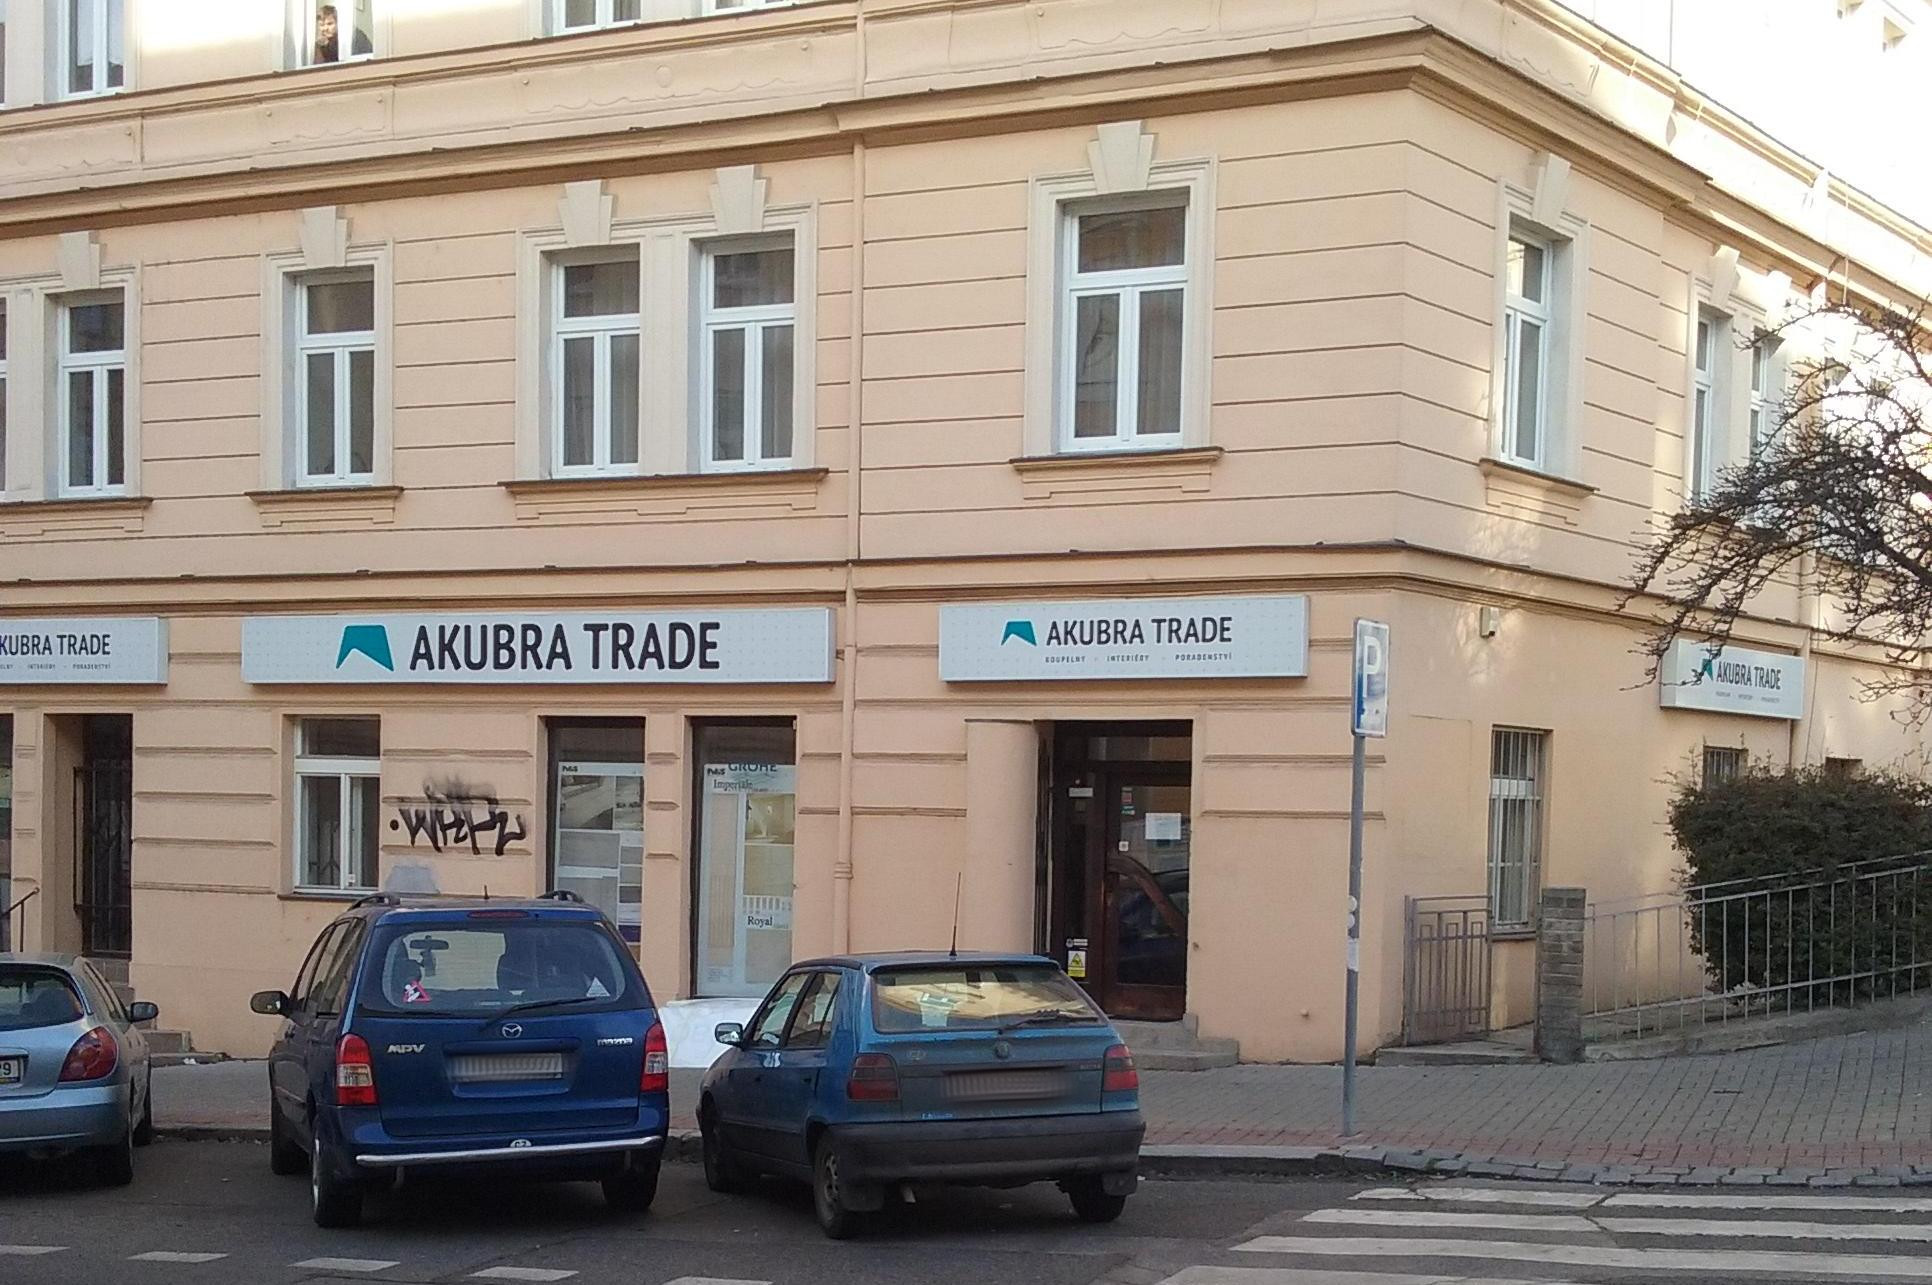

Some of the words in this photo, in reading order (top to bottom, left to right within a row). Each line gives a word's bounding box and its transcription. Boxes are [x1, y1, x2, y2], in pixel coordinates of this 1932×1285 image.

[1045, 618, 1145, 646] AKUBRA
[1151, 616, 1232, 643] TRADE
[56, 634, 111, 655] TRADE
[409, 623, 573, 671] AKUBRA
[583, 621, 721, 670] TRADE
[1362, 635, 1382, 698] P
[1716, 661, 1752, 686] AKUBRA
[1754, 666, 1781, 690] TRADE
[728, 761, 778, 772] GROHE
[747, 915, 773, 928] Royal
[387, 1044, 426, 1054] MPV
